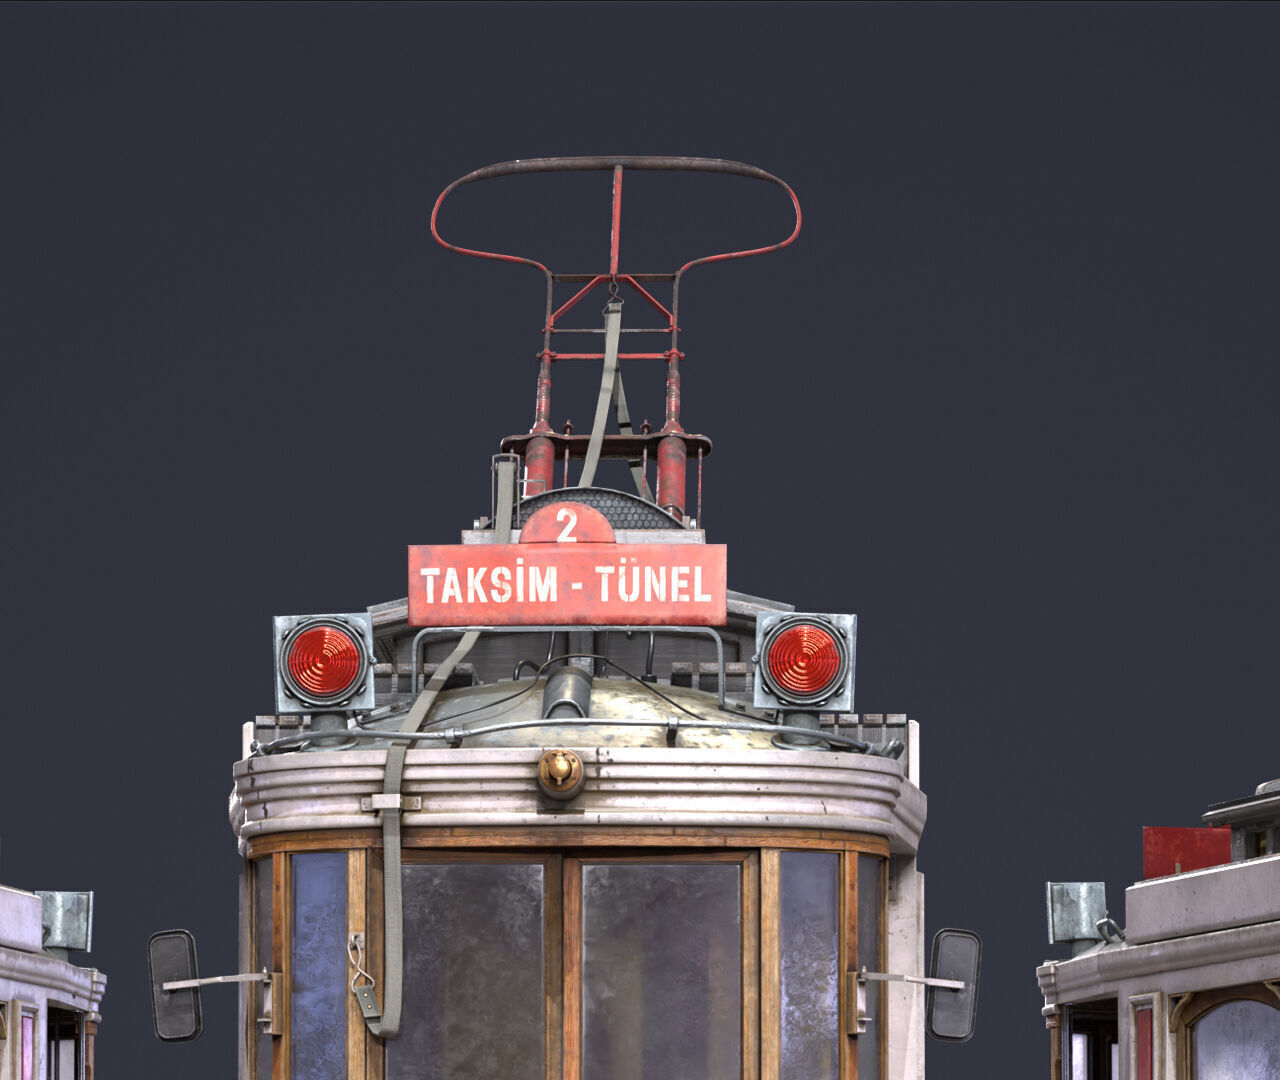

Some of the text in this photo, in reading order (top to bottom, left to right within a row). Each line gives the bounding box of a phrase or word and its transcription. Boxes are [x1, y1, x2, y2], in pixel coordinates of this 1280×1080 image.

[556, 508, 578, 543] 2
[420, 557, 558, 604] TAKSİM
[595, 557, 712, 603] TÜNEL
